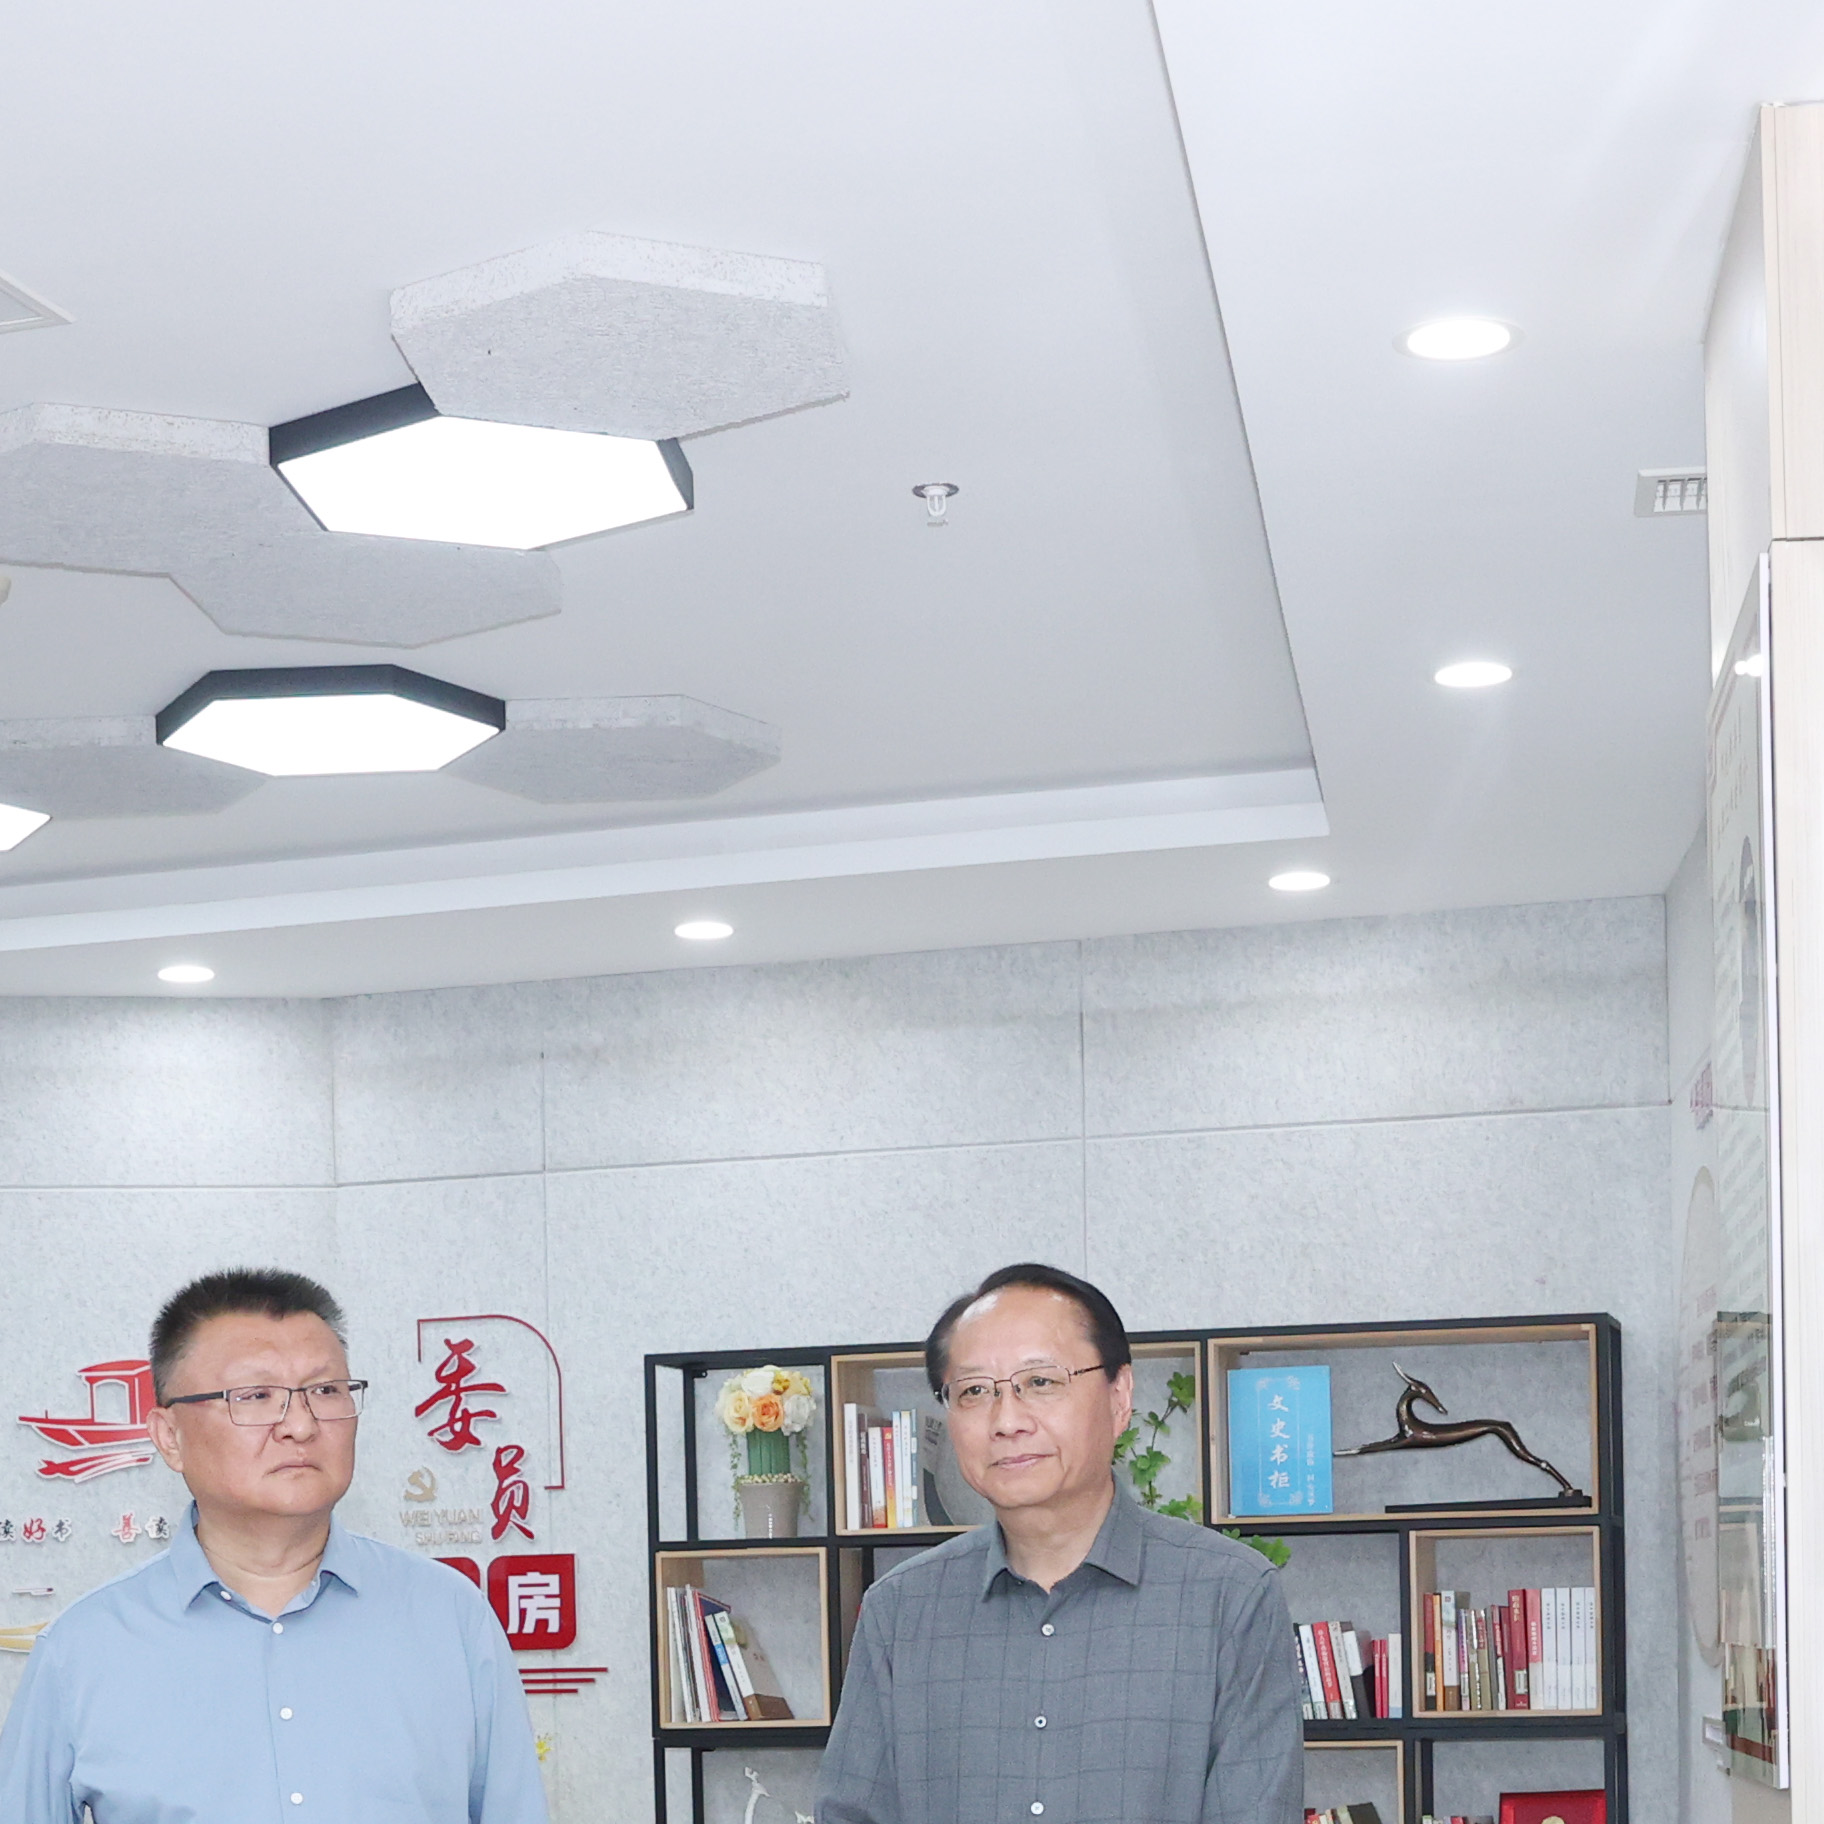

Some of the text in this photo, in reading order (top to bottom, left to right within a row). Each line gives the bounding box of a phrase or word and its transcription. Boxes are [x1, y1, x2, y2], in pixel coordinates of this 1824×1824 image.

[415, 1338, 535, 1541] 委员
[1268, 1394, 1291, 1489] 文史书柜
[433, 1508, 482, 1526] YUAN
[507, 1572, 561, 1634] 房
